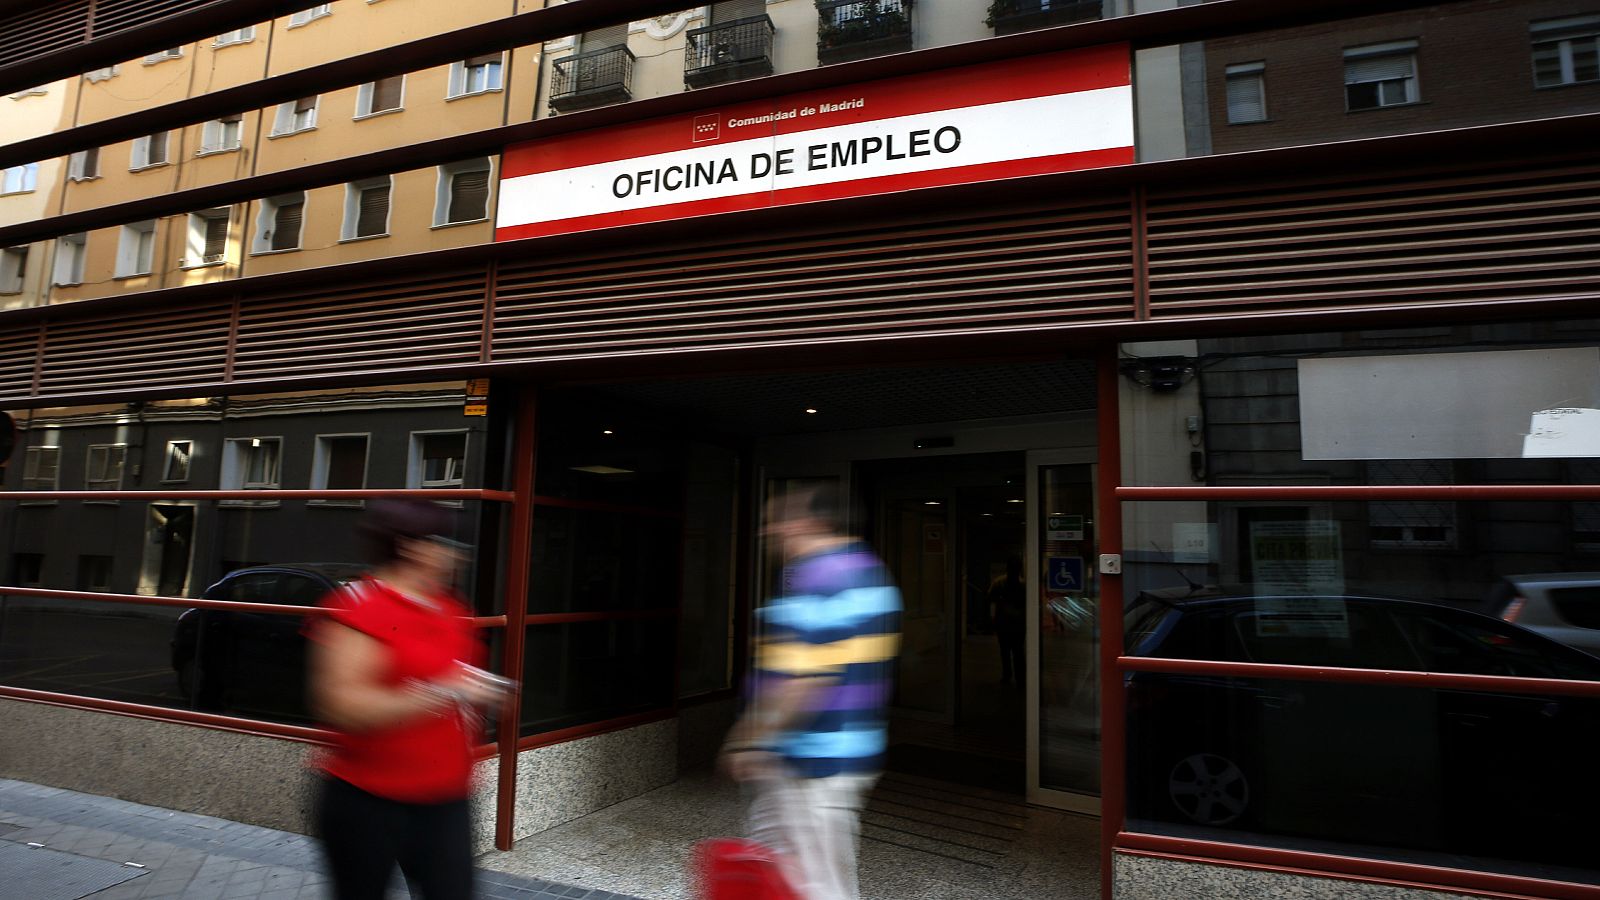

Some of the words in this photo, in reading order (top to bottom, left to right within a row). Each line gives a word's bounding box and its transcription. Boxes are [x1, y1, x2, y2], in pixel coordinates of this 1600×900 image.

[727, 108, 798, 129] Comunidad
[800, 106, 817, 117] de
[819, 98, 865, 114] Madrid
[612, 157, 738, 199] OFICINA
[750, 149, 795, 179] DE
[807, 125, 962, 172] EMPLEO
